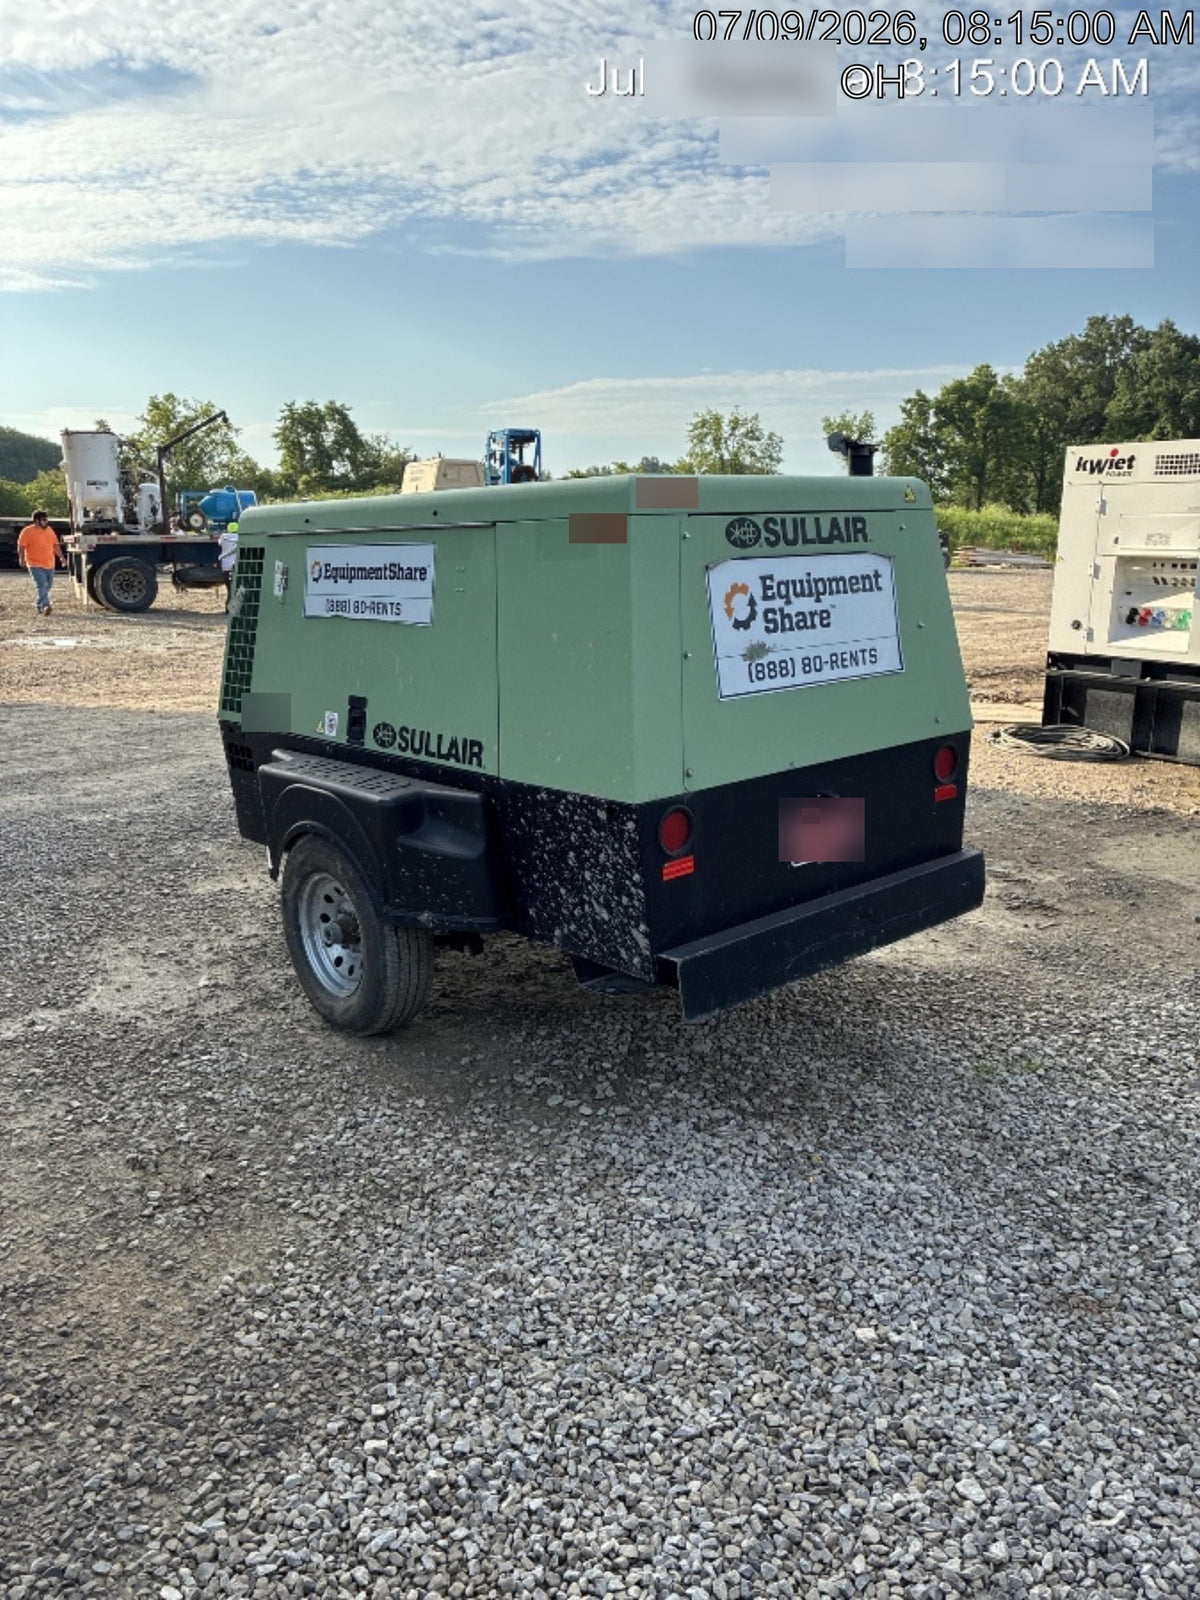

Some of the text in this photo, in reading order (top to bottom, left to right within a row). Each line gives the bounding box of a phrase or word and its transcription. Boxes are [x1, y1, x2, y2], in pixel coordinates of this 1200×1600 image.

[1075, 448, 1136, 475] kwiet
[763, 516, 869, 547] SULLAIR
[323, 563, 428, 584] EquipmentShare
[759, 569, 882, 605] Equipment
[326, 598, 402, 616] (888) 80-RENTS
[763, 607, 832, 634] Share
[748, 648, 878, 683] (888) 80-RENTS
[398, 726, 484, 769] SULLAIR
